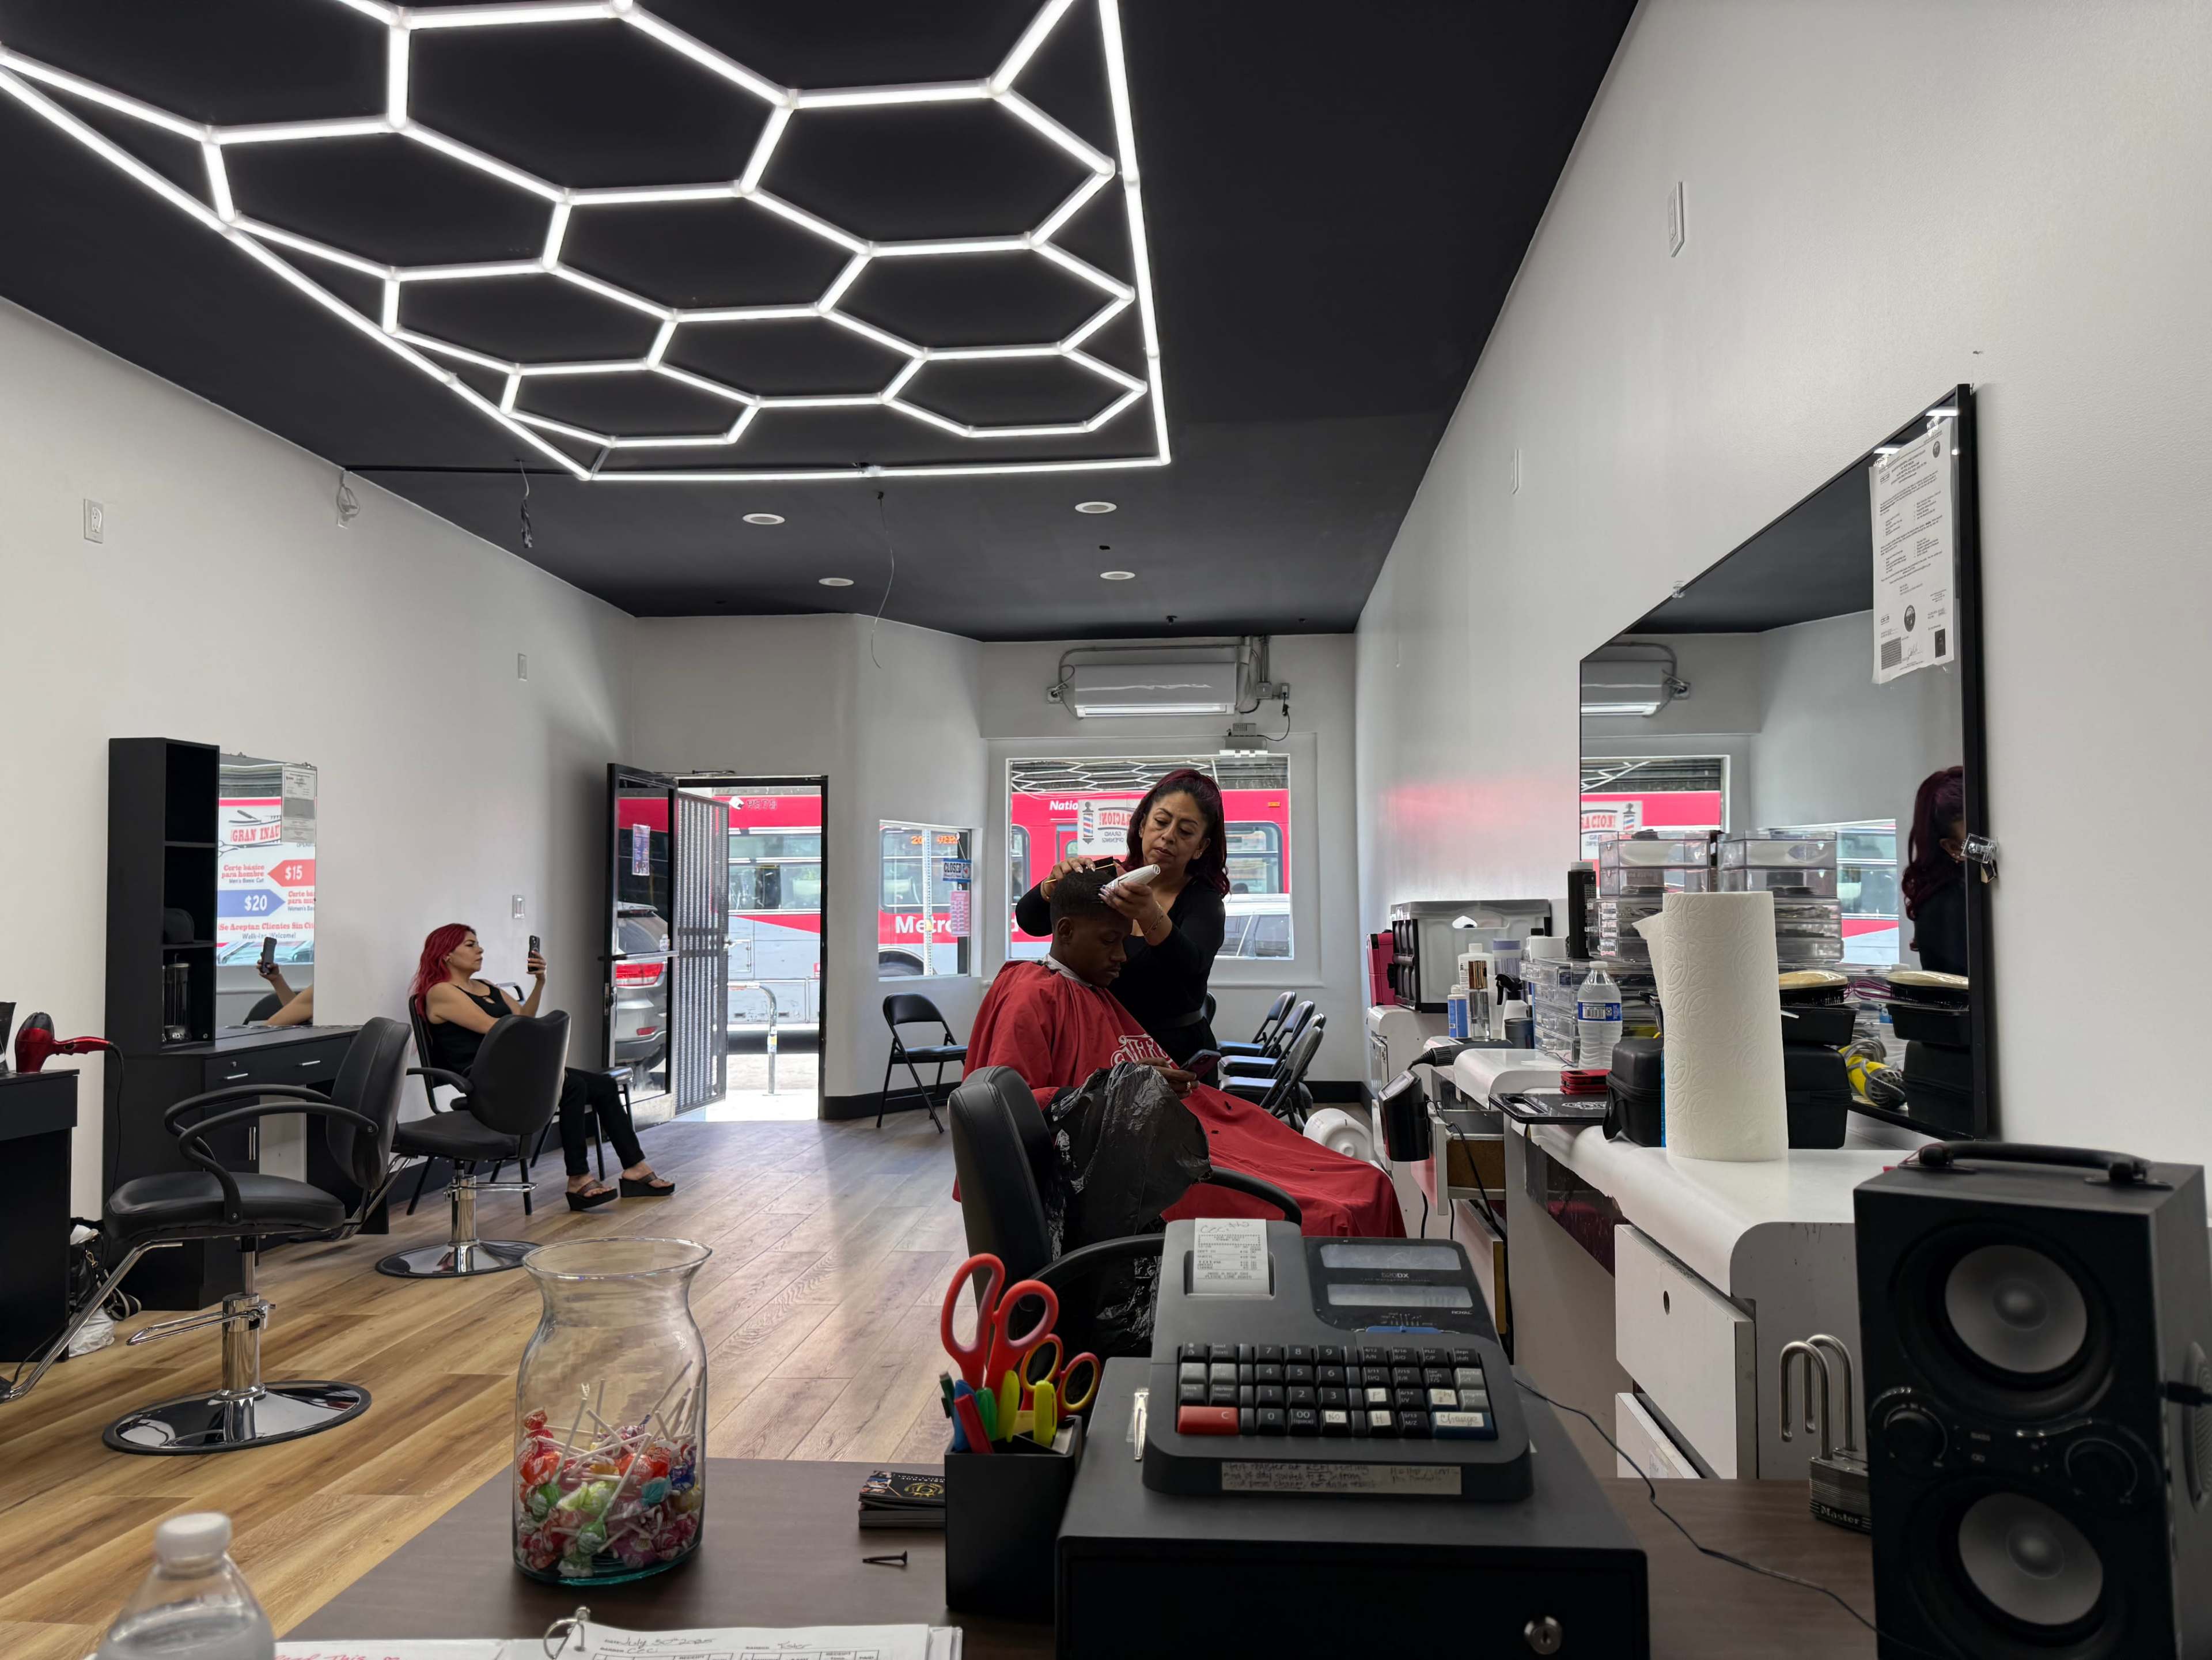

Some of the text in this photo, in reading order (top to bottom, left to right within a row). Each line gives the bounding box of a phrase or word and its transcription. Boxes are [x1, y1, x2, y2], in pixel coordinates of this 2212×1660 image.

[285, 865, 303, 880] $15
[944, 862, 961, 874] CLOSED
[244, 894, 267, 912] $20
[230, 923, 260, 931] Aceptan
[1440, 1413, 1480, 1426] Change
[1821, 1505, 1859, 1524] Master
